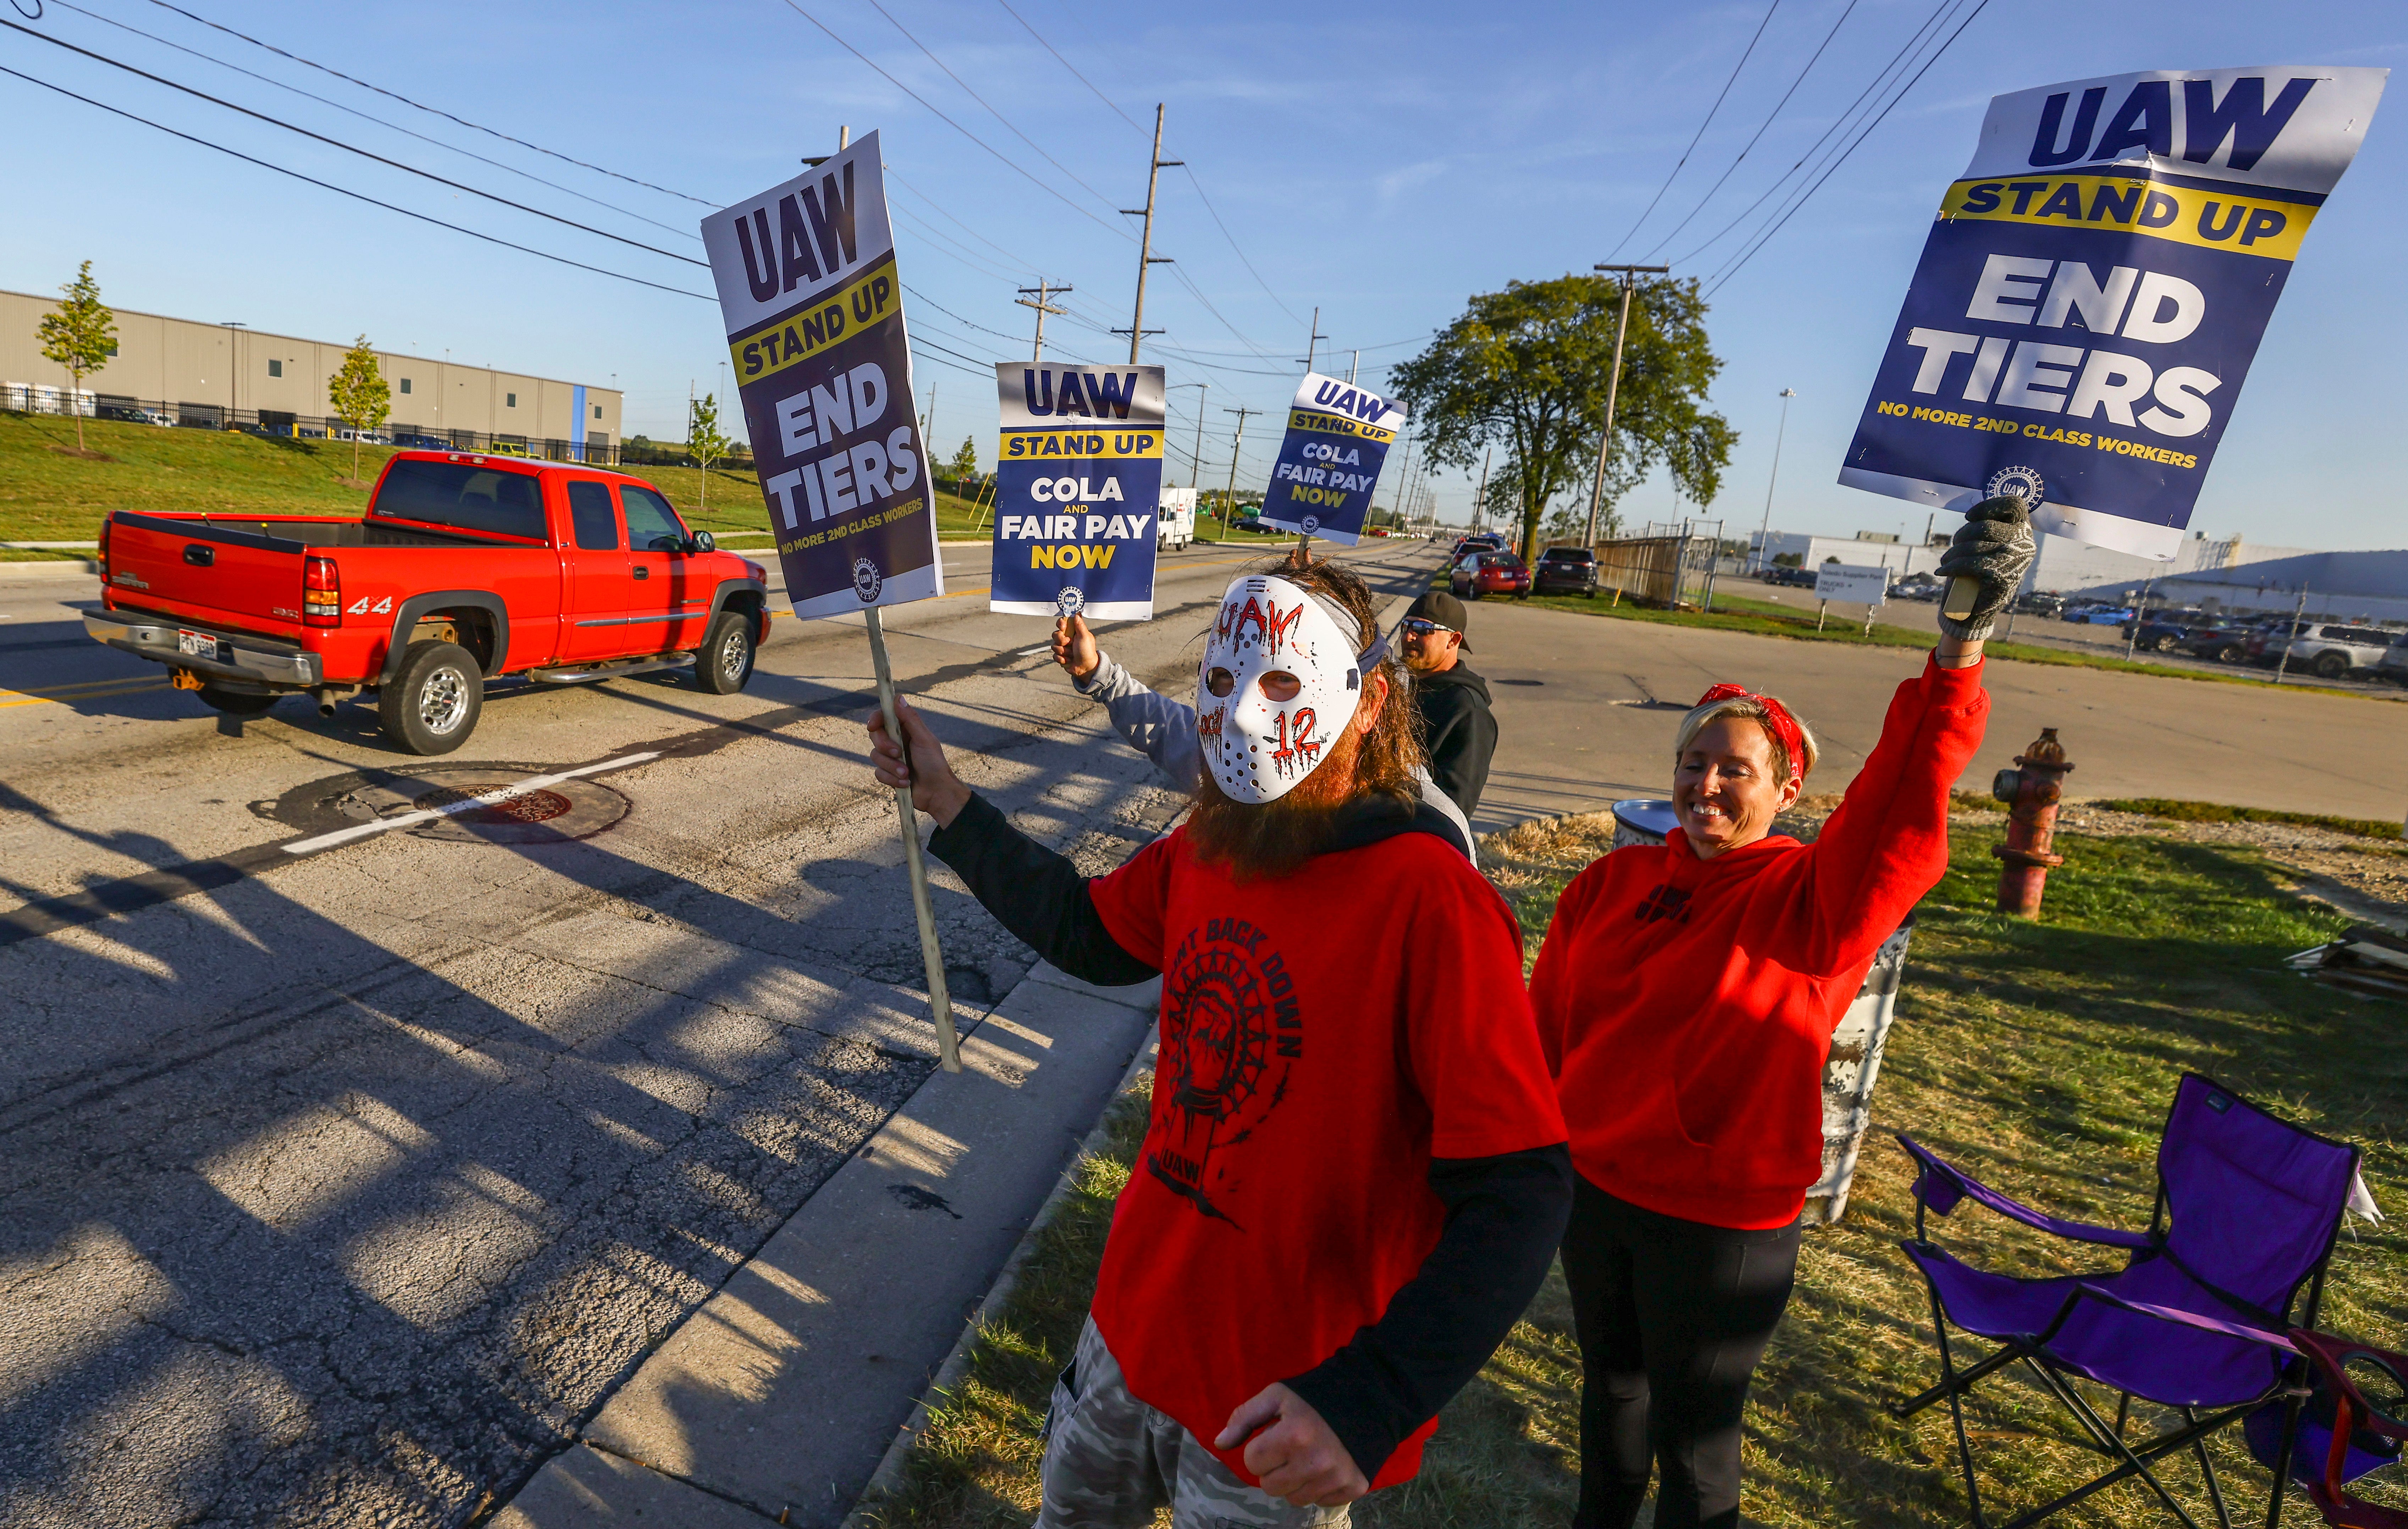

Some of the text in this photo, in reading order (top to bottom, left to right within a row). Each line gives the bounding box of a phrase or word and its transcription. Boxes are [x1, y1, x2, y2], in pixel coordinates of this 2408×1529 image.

[2028, 77, 2318, 171] UAW
[735, 160, 856, 302] UAW
[1960, 182, 2286, 246] STAND UP
[1966, 254, 2205, 343] END
[743, 276, 889, 375] STAND UP
[1024, 369, 1138, 419] UAW
[1315, 381, 1392, 423] UAW
[1909, 326, 2222, 437] TIERS
[775, 363, 887, 457] END
[1294, 414, 1388, 439] STAND UP
[1878, 401, 2198, 468] NO MORE 2ND CLASS WORKERS
[1008, 435, 1154, 456] STAND UP
[1302, 443, 1359, 466] COLA
[767, 426, 917, 530] TIERS
[1031, 476, 1124, 502] COLA
[1277, 463, 1374, 492] FAIR PAY
[1291, 485, 1347, 508] NOW
[2003, 483, 2028, 497] UAW
[781, 498, 923, 555] NO MORE 2ND CLASS WORKERS
[1001, 515, 1151, 540] FAIR PAY
[1063, 504, 1088, 513] AND
[859, 574, 871, 584] UAW
[1031, 545, 1116, 569] NOW
[1218, 596, 1303, 655] UAW
[1272, 707, 1320, 761] 12
[1205, 917, 1267, 955] BACK
[1259, 952, 1302, 1058] DOWN
[1163, 1148, 1200, 1184] UAW
